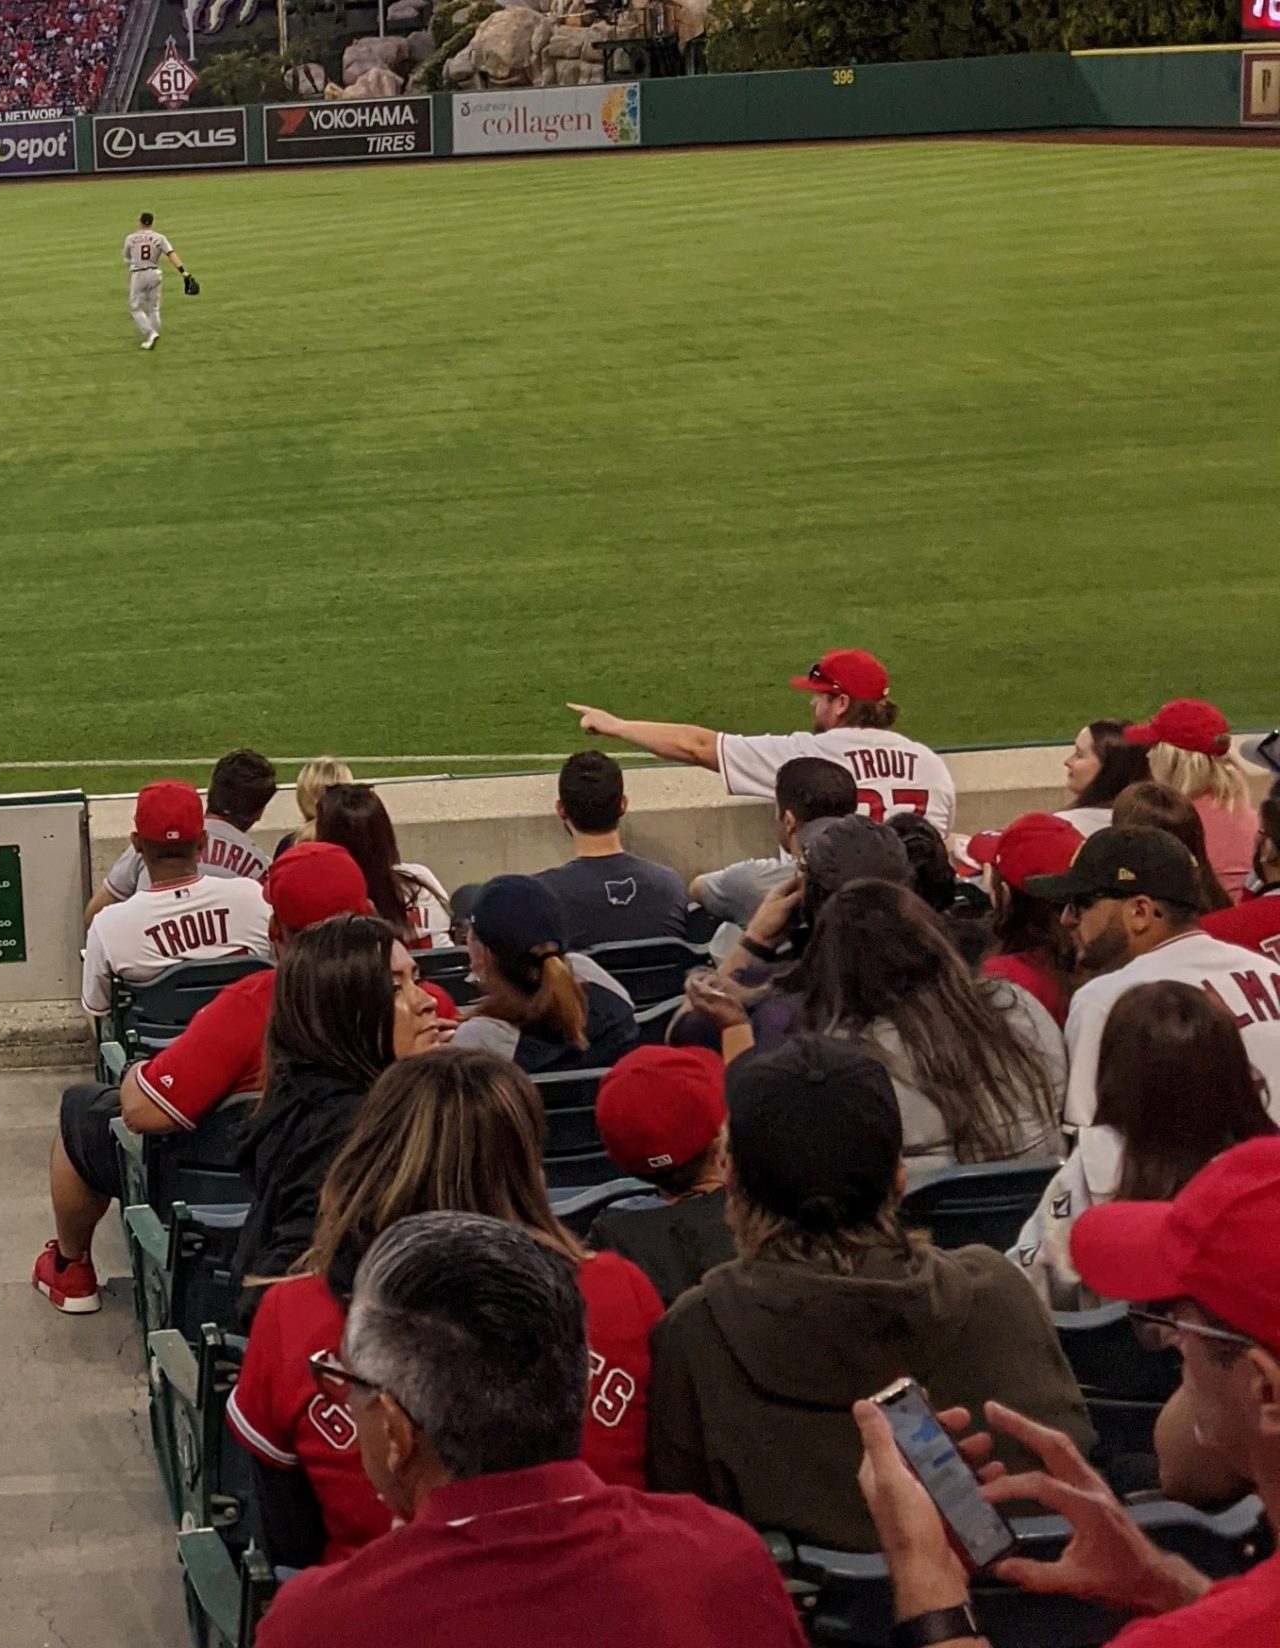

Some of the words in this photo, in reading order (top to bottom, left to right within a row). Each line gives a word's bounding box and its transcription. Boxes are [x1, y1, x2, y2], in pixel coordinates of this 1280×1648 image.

[159, 70, 186, 92] 60
[832, 69, 854, 85] 396
[308, 105, 415, 131] YOKOHAMA
[482, 106, 592, 143] collagen
[138, 127, 237, 149] LEXUS
[366, 134, 415, 154] TIRES
[140, 245, 152, 261] 8
[844, 748, 918, 781] TROUT
[144, 908, 230, 957] TROUT
